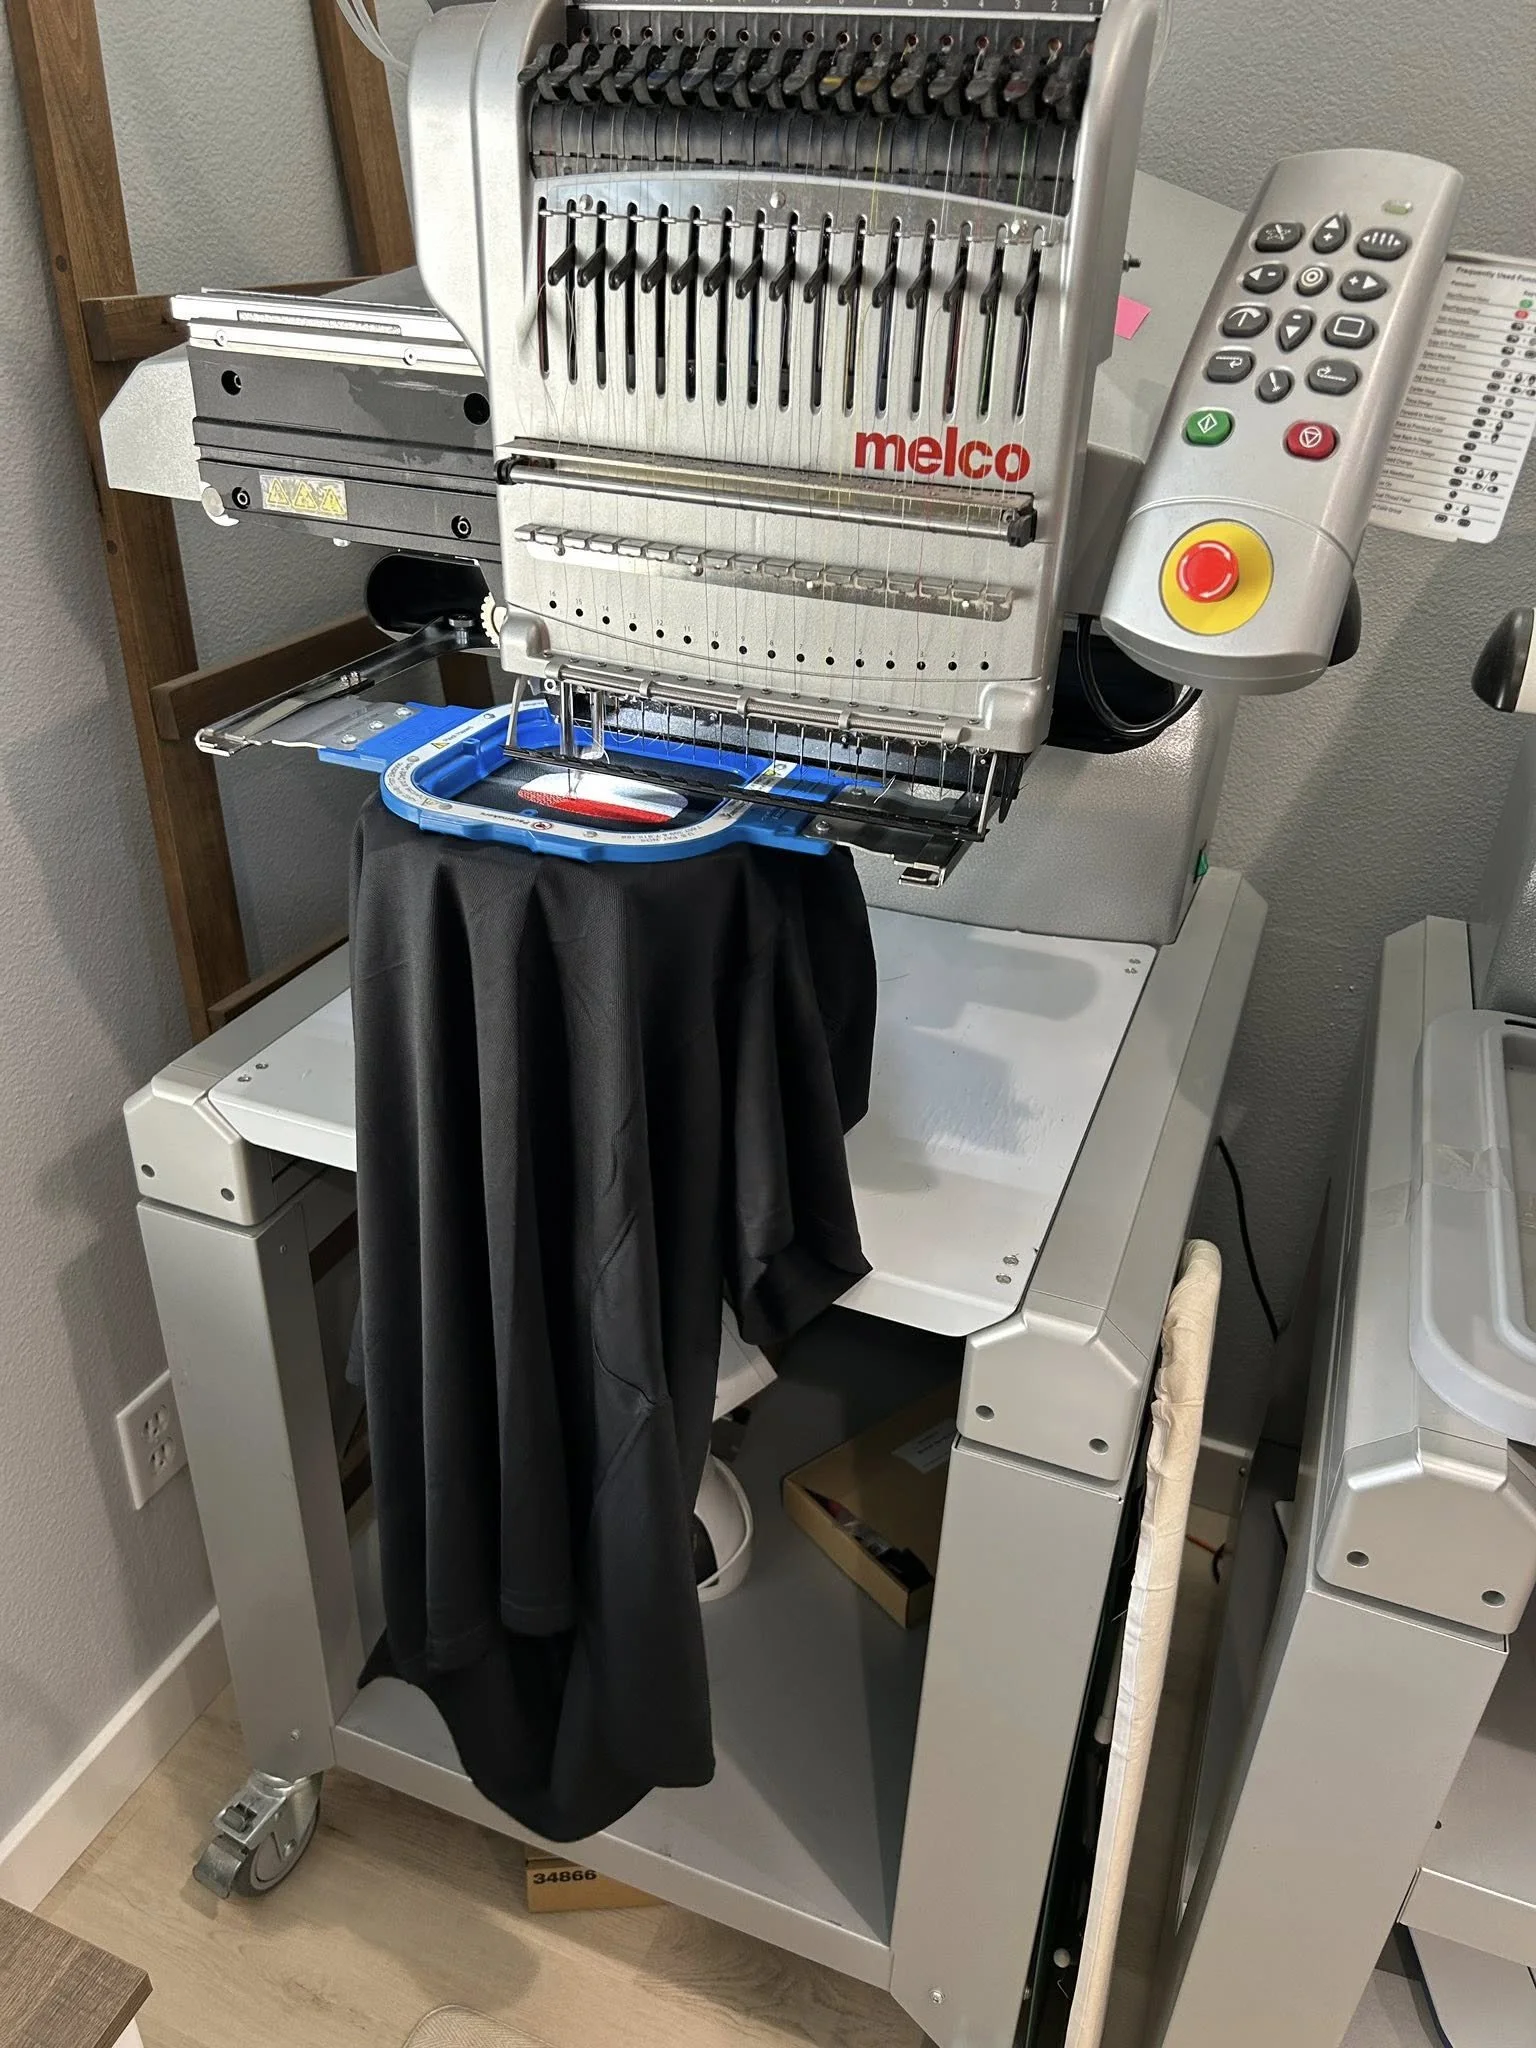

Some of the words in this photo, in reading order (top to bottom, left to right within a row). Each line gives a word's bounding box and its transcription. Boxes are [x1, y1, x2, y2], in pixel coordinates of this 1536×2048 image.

[1014, 0, 1021, 10] 3
[1051, 0, 1058, 11] 2
[1088, 2, 1094, 12] 1
[854, 426, 1031, 483] melco
[533, 1869, 597, 1885] 34866
